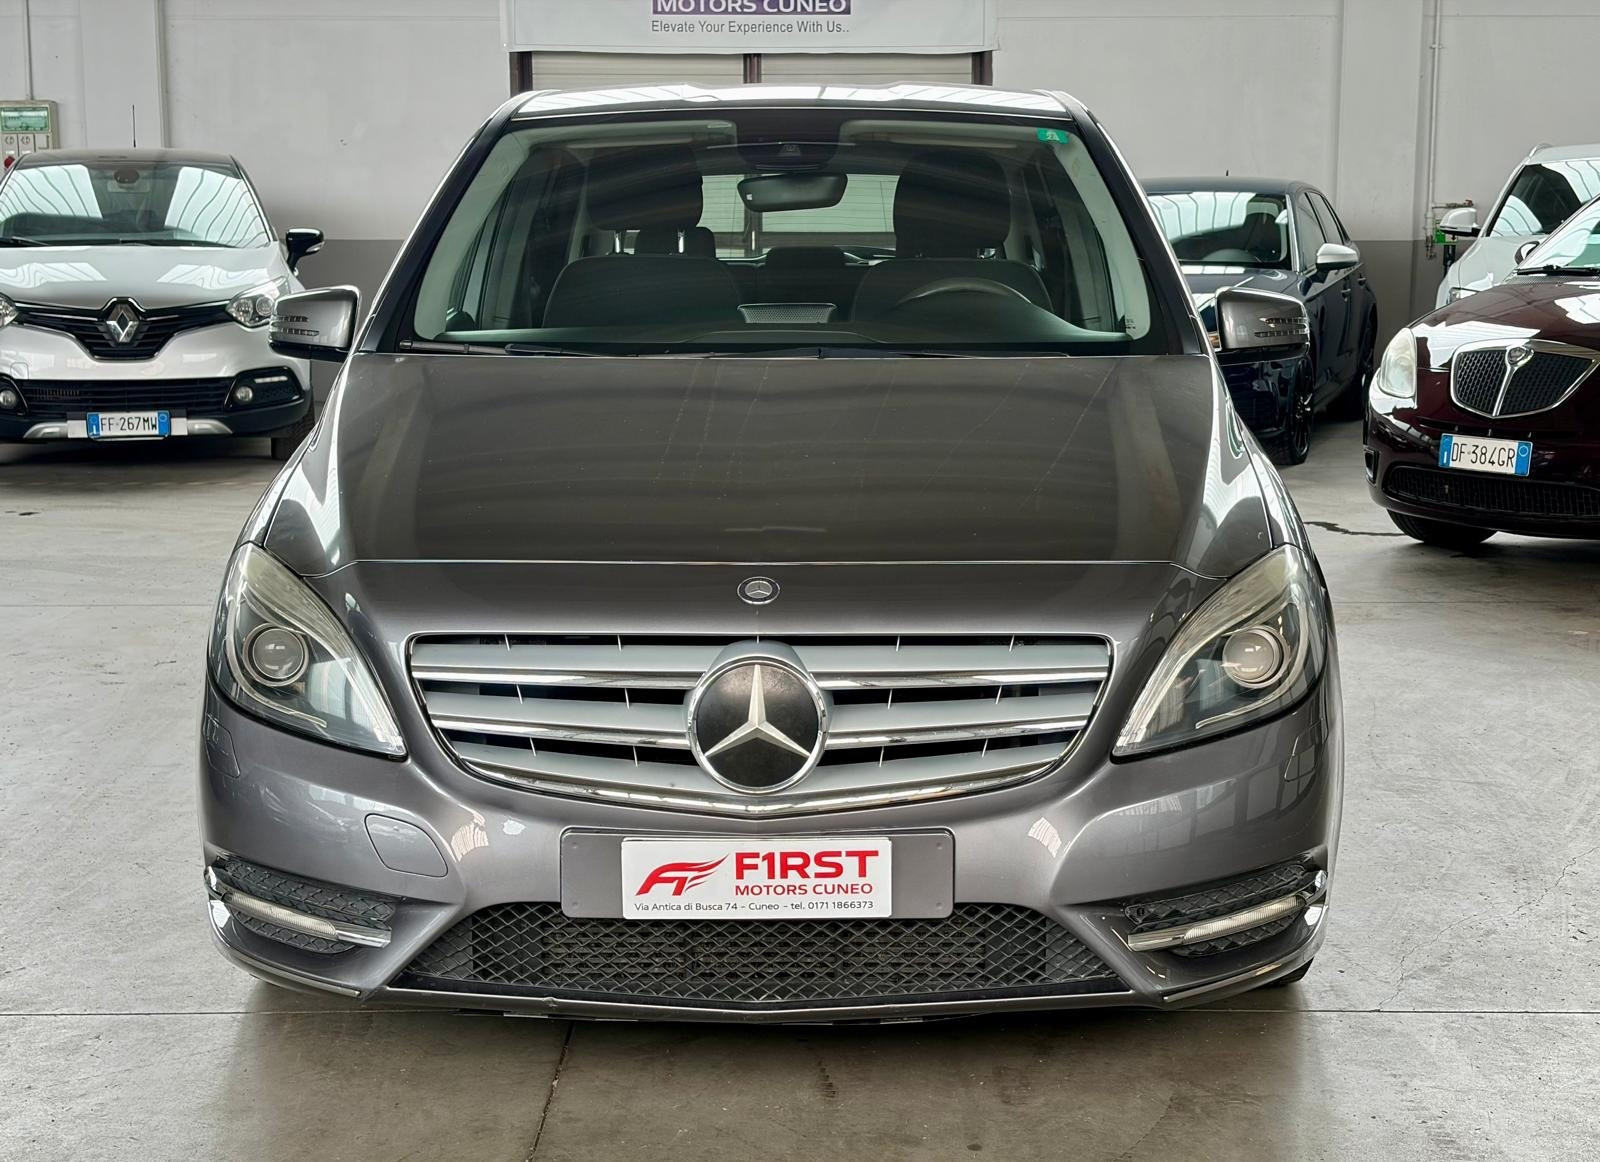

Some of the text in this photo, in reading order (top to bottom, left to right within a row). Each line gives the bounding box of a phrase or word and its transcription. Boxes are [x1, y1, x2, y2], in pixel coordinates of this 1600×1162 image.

[657, 0, 847, 13] MOTORS CUNEO
[651, 20, 695, 32] Elevate
[698, 20, 725, 32] Your
[728, 21, 793, 36] Experience
[797, 20, 823, 32] With
[735, 850, 879, 880] F1RST
[735, 883, 873, 896] MOTORS CUNEO
[634, 903, 649, 911] Via
[651, 903, 682, 911] Antica
[684, 903, 693, 911] di
[695, 903, 723, 911] Busca
[725, 903, 738, 911] 74
[748, 902, 780, 911] Cuneo
[791, 902, 805, 910] tel.
[808, 901, 829, 910] 0171
[832, 901, 874, 909] 1866373
